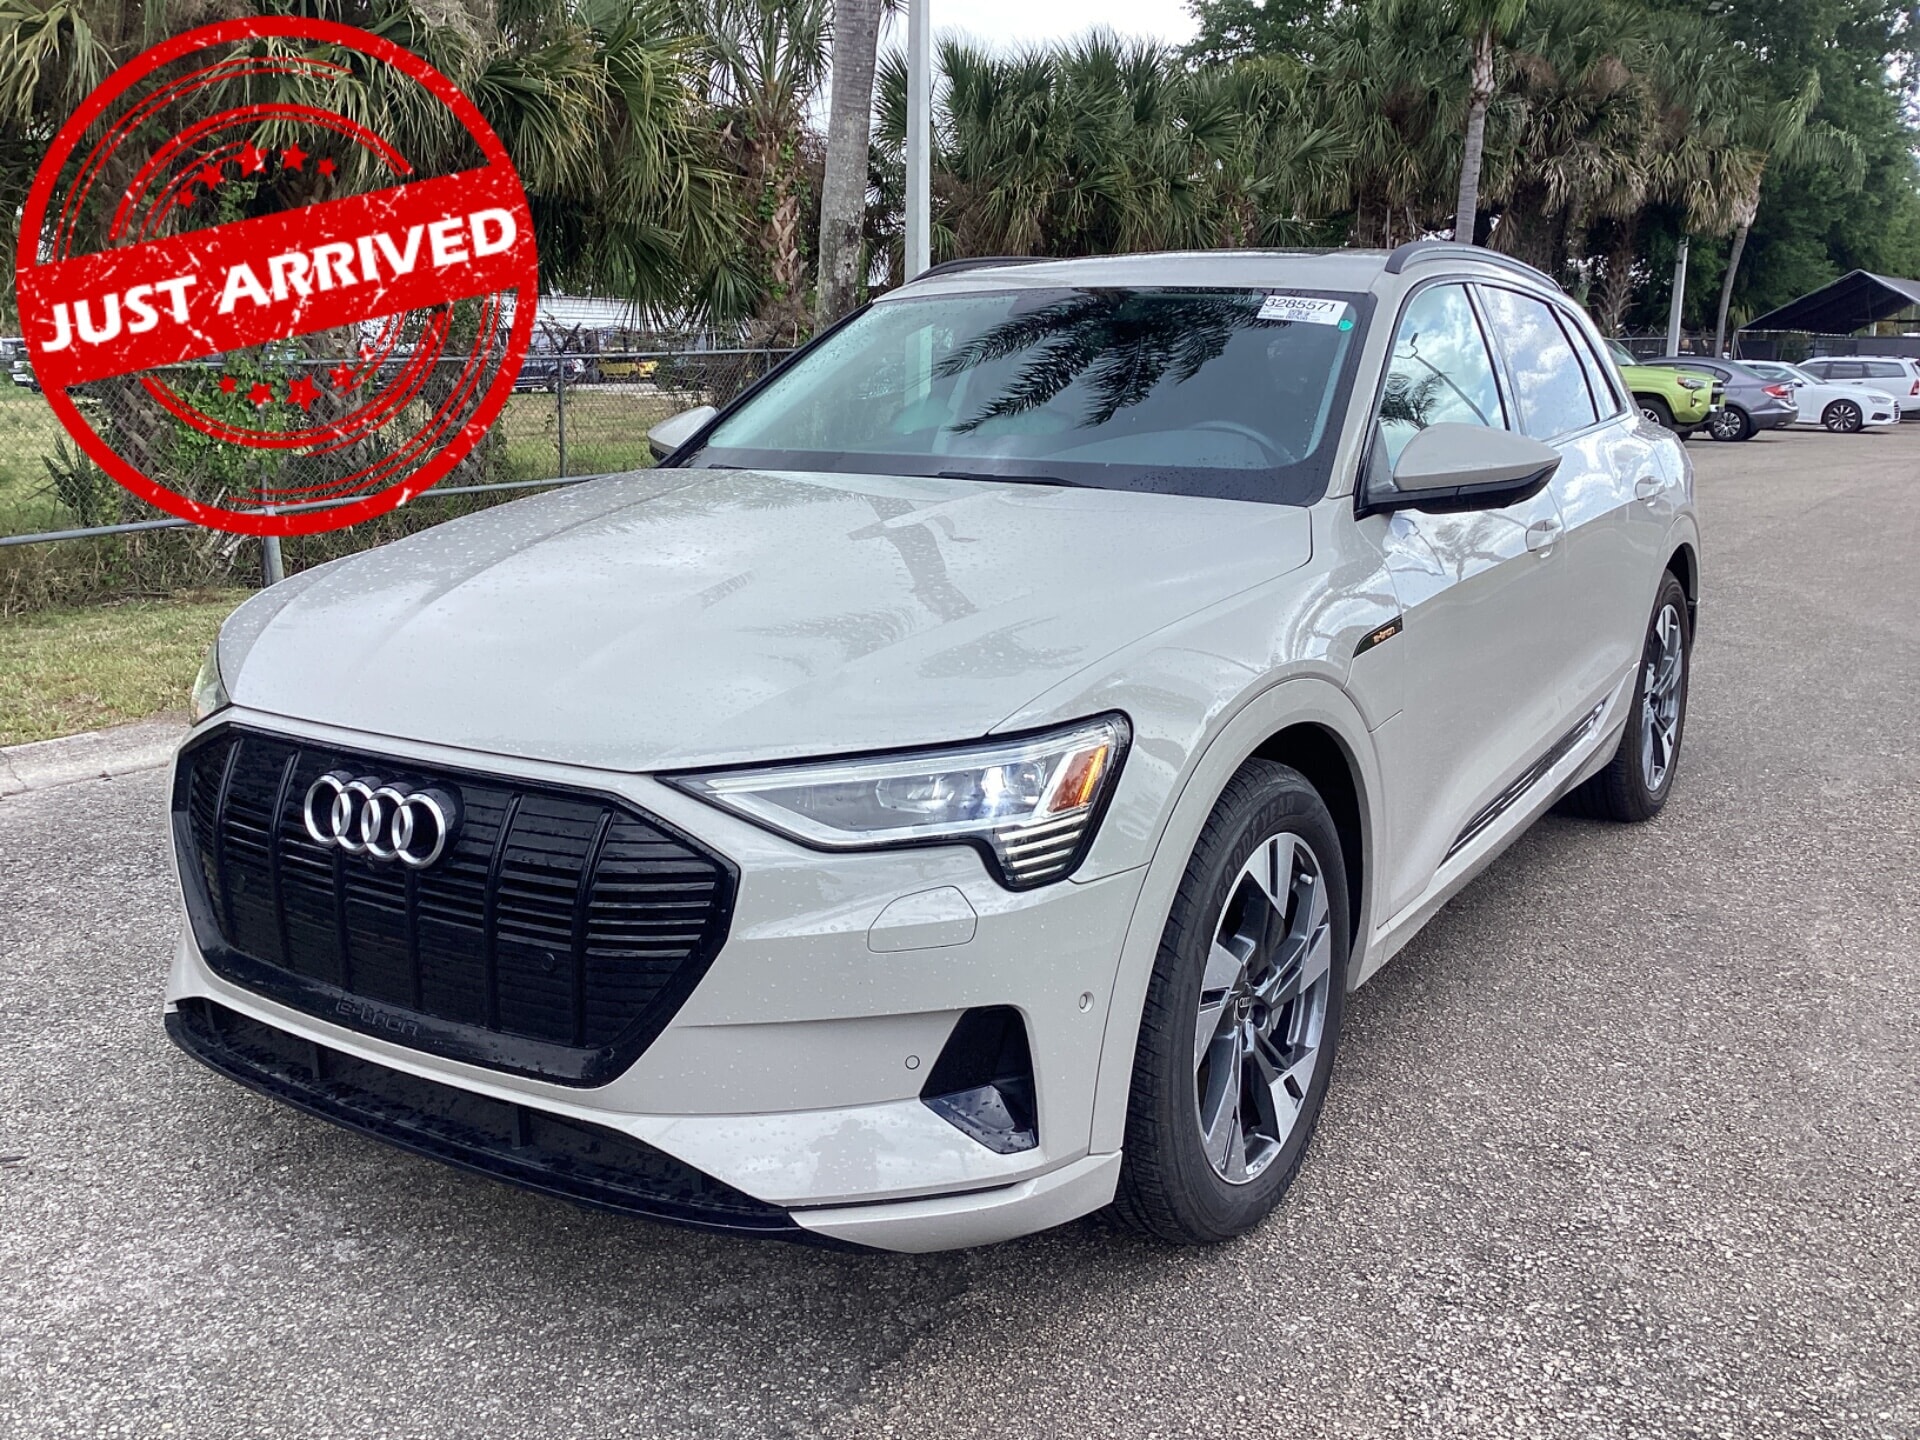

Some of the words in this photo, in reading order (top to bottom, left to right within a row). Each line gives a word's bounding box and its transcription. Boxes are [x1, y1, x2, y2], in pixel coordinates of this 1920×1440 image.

[1264, 298, 1336, 313] 3285571
[1216, 796, 1295, 907] GOODYEAR
[335, 1000, 418, 1037] e-tron
